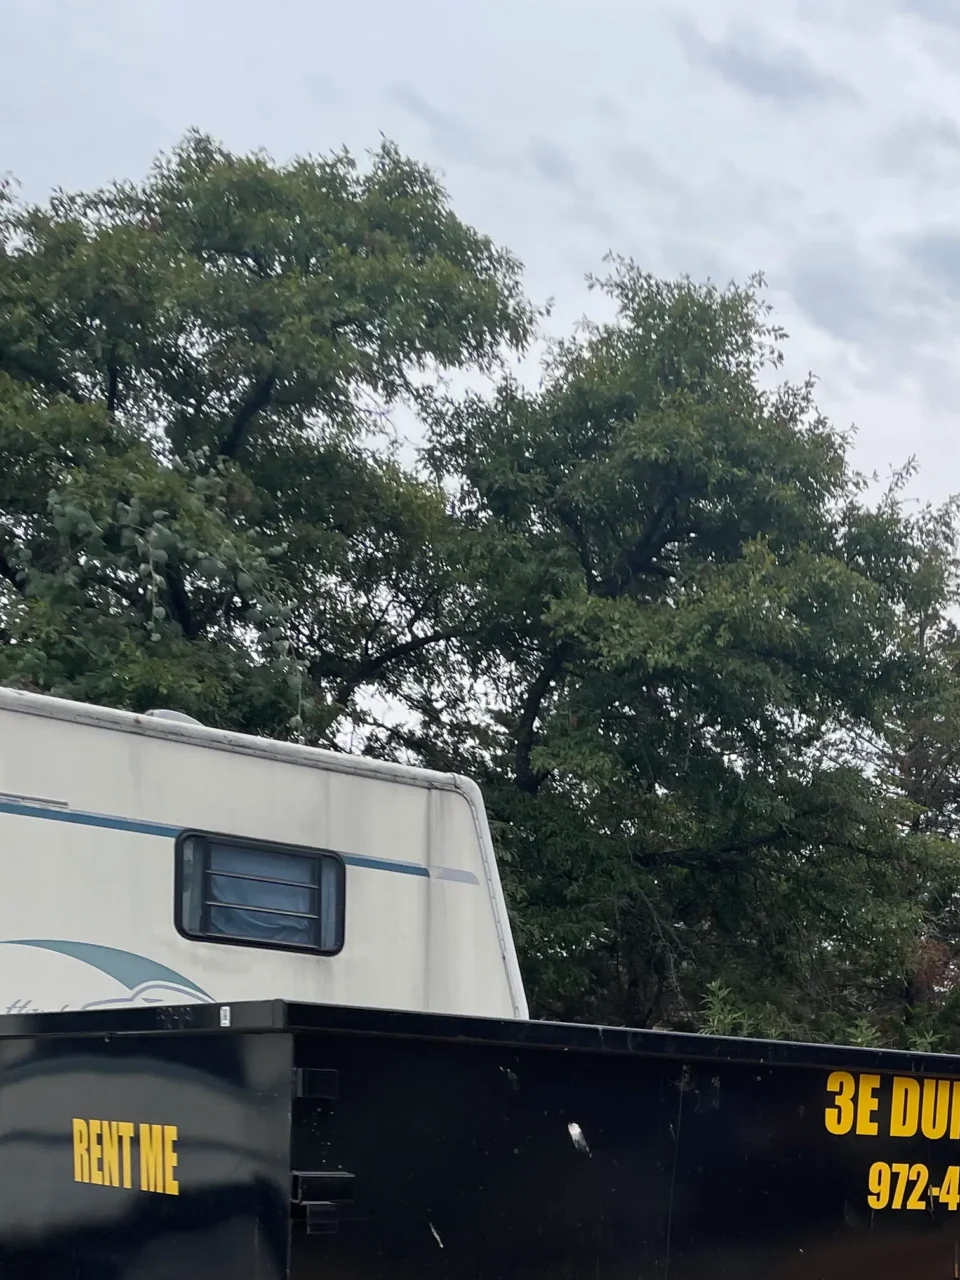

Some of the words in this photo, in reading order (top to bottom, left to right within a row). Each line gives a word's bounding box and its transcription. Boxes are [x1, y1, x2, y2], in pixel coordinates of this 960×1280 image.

[824, 1071, 881, 1136] 3E
[72, 1117, 135, 1189] RENT
[139, 1123, 179, 1196] ME
